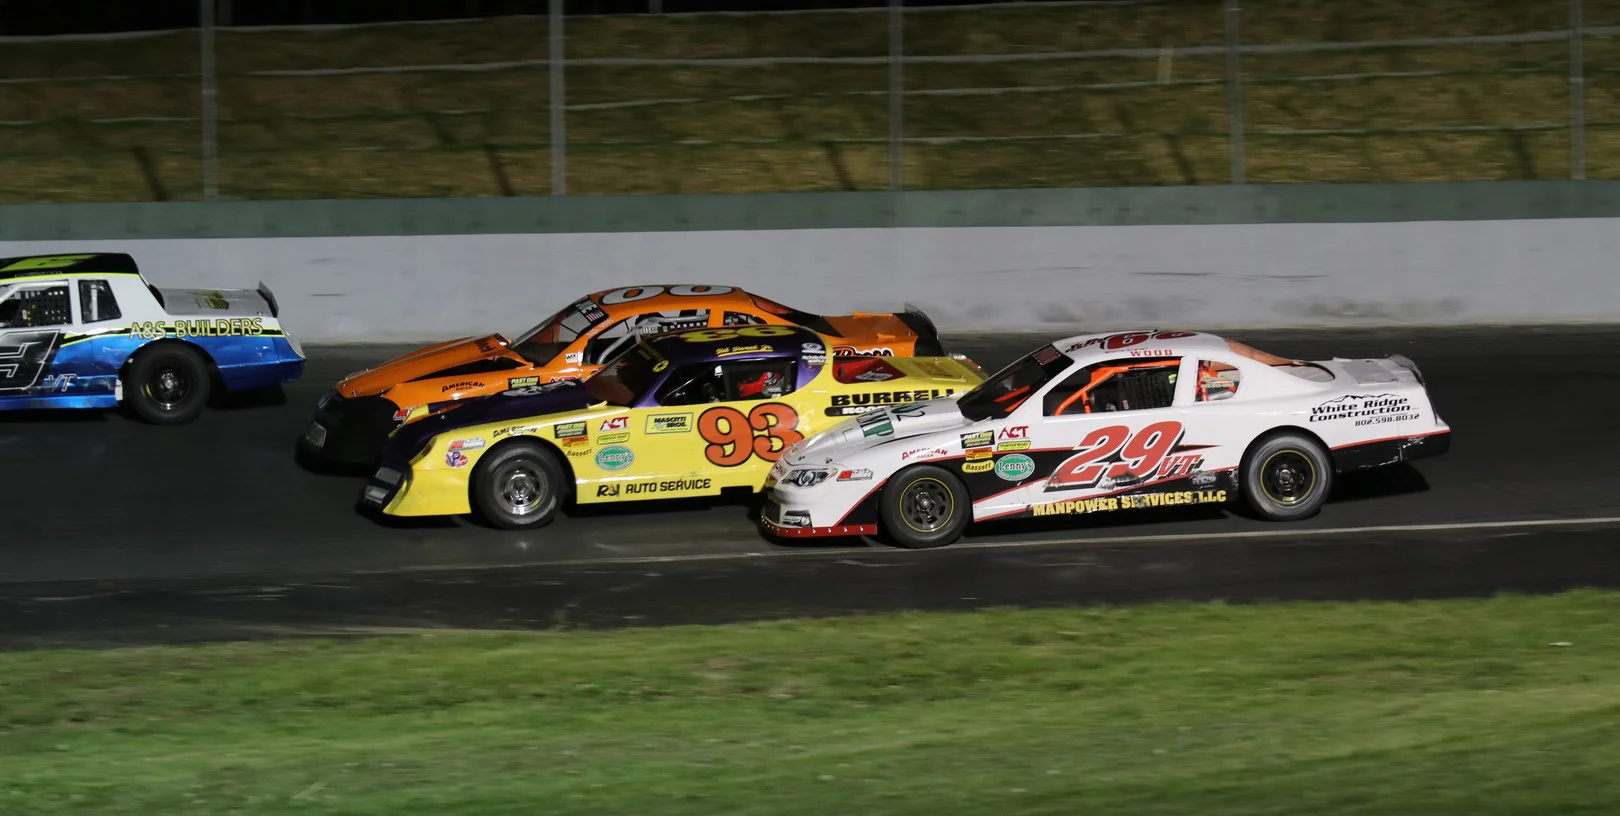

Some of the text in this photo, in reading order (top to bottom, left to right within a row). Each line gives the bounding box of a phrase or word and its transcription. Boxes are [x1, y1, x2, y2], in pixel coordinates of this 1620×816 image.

[129, 317, 263, 340] A&S BUILDERS
[1131, 349, 1172, 357] WOOD
[442, 381, 485, 392] AMERICAN
[1309, 404, 1410, 422] Construction
[1312, 403, 1357, 415] White
[1364, 398, 1408, 409] Ridge
[600, 417, 629, 431] ACT
[998, 425, 1029, 439] ACT
[697, 402, 804, 467] 93
[1044, 420, 1203, 491] 29 VT
[965, 461, 991, 471] Bassett
[999, 460, 1032, 472] Lenny's
[626, 480, 657, 495] AUTO
[660, 478, 711, 492] SERVICE
[1033, 498, 1118, 516] MANPOWER
[1199, 490, 1226, 503] LLC
